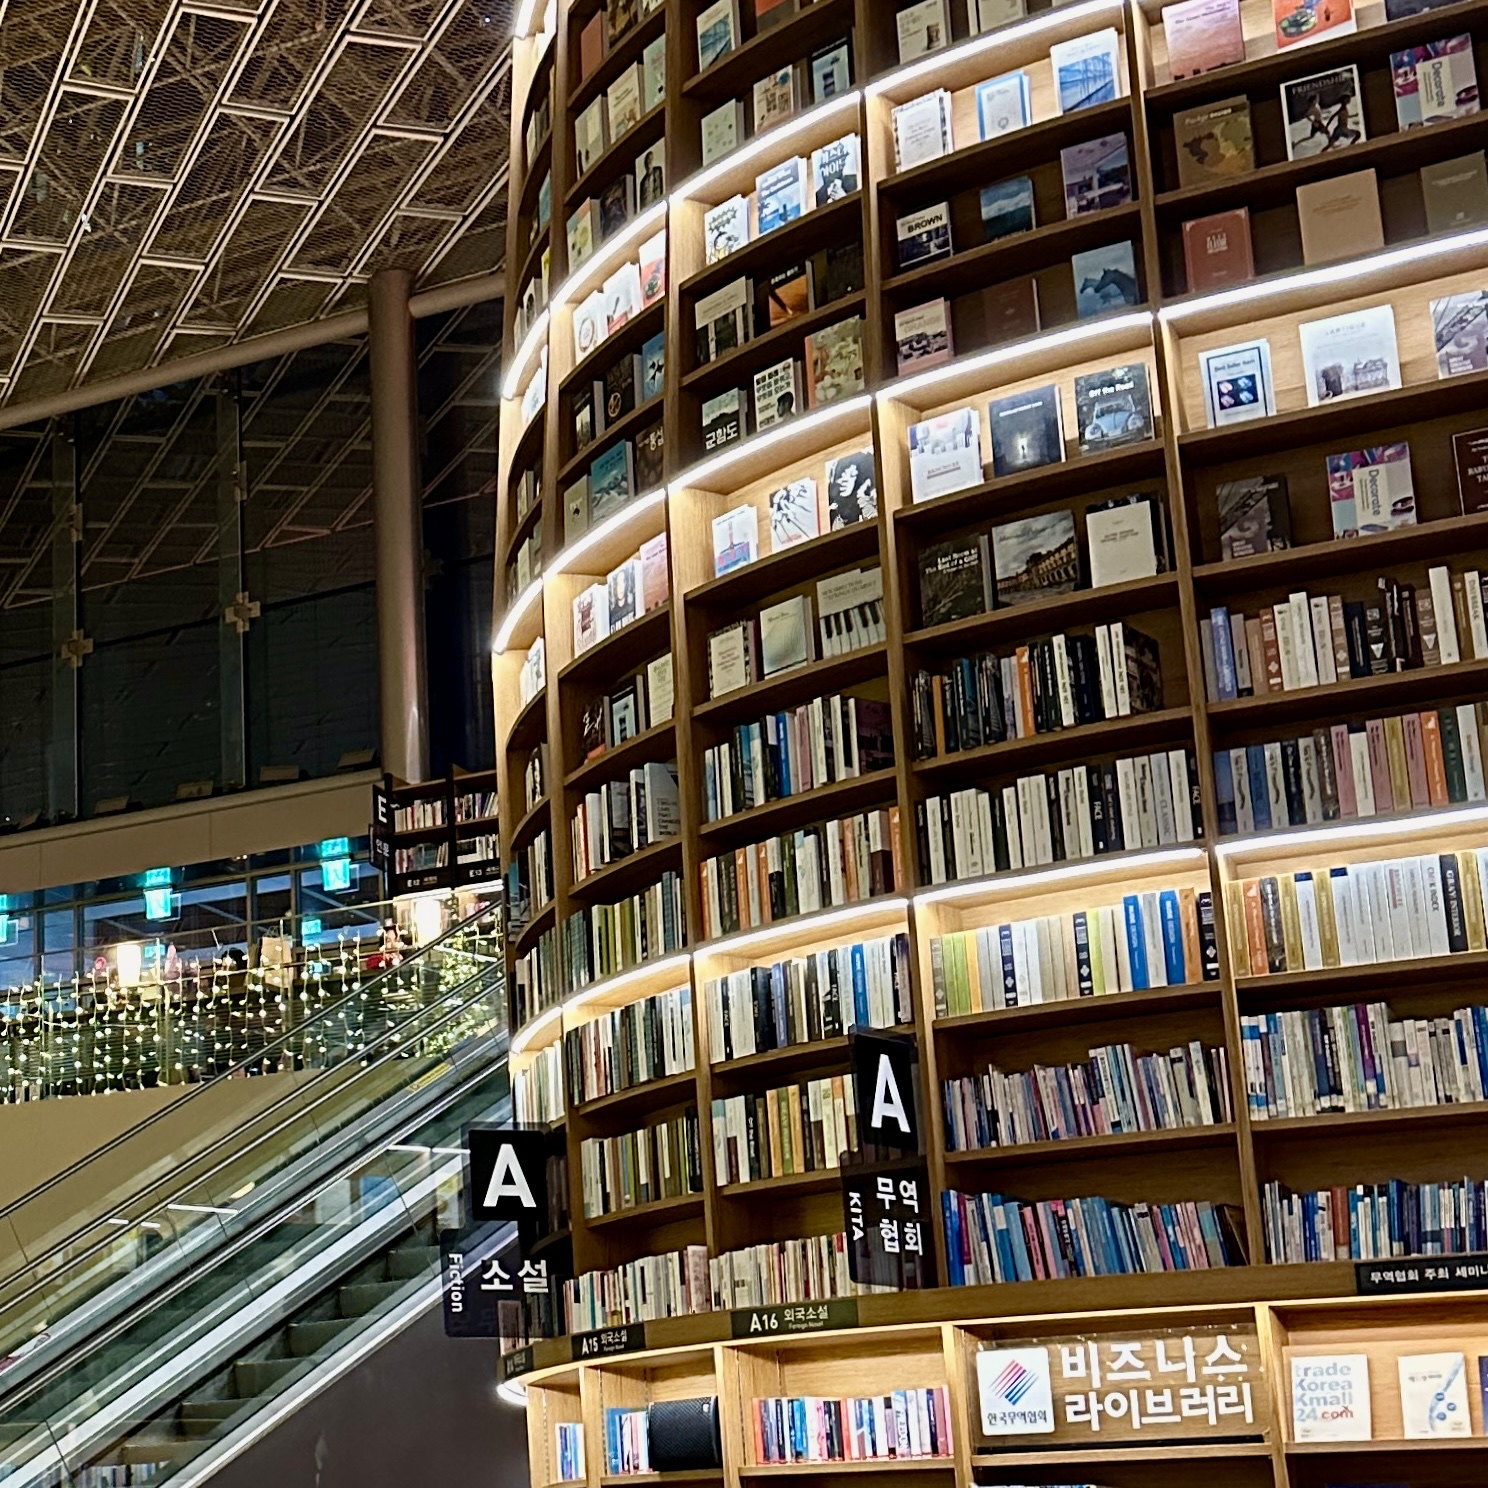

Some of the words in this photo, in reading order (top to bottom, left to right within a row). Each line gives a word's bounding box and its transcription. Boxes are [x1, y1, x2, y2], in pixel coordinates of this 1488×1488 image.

[907, 213, 943, 234] BROWN
[705, 421, 738, 450] 군함도
[1368, 468, 1381, 516] Decorate
[378, 794, 388, 823] E
[1445, 869, 1456, 897] GRAY
[871, 1053, 911, 1133] A
[483, 1143, 537, 1208] A
[876, 1176, 919, 1213] 무역
[848, 1191, 865, 1241] KITA
[879, 1218, 923, 1256] 협회
[448, 1252, 465, 1313] Fiction
[481, 1259, 549, 1294] 소설
[1370, 1269, 1419, 1284] 무역협회
[749, 1312, 779, 1333] A16
[783, 1304, 829, 1322] 외국소설
[581, 1336, 598, 1356] A15
[600, 1328, 628, 1345] 외국소설
[1061, 1335, 1248, 1389] 비즈니스
[1295, 1362, 1352, 1378] trade
[1295, 1377, 1353, 1392] Korea
[986, 1409, 1048, 1428] 한국무역협회
[1064, 1382, 1254, 1432] 라이브러리
